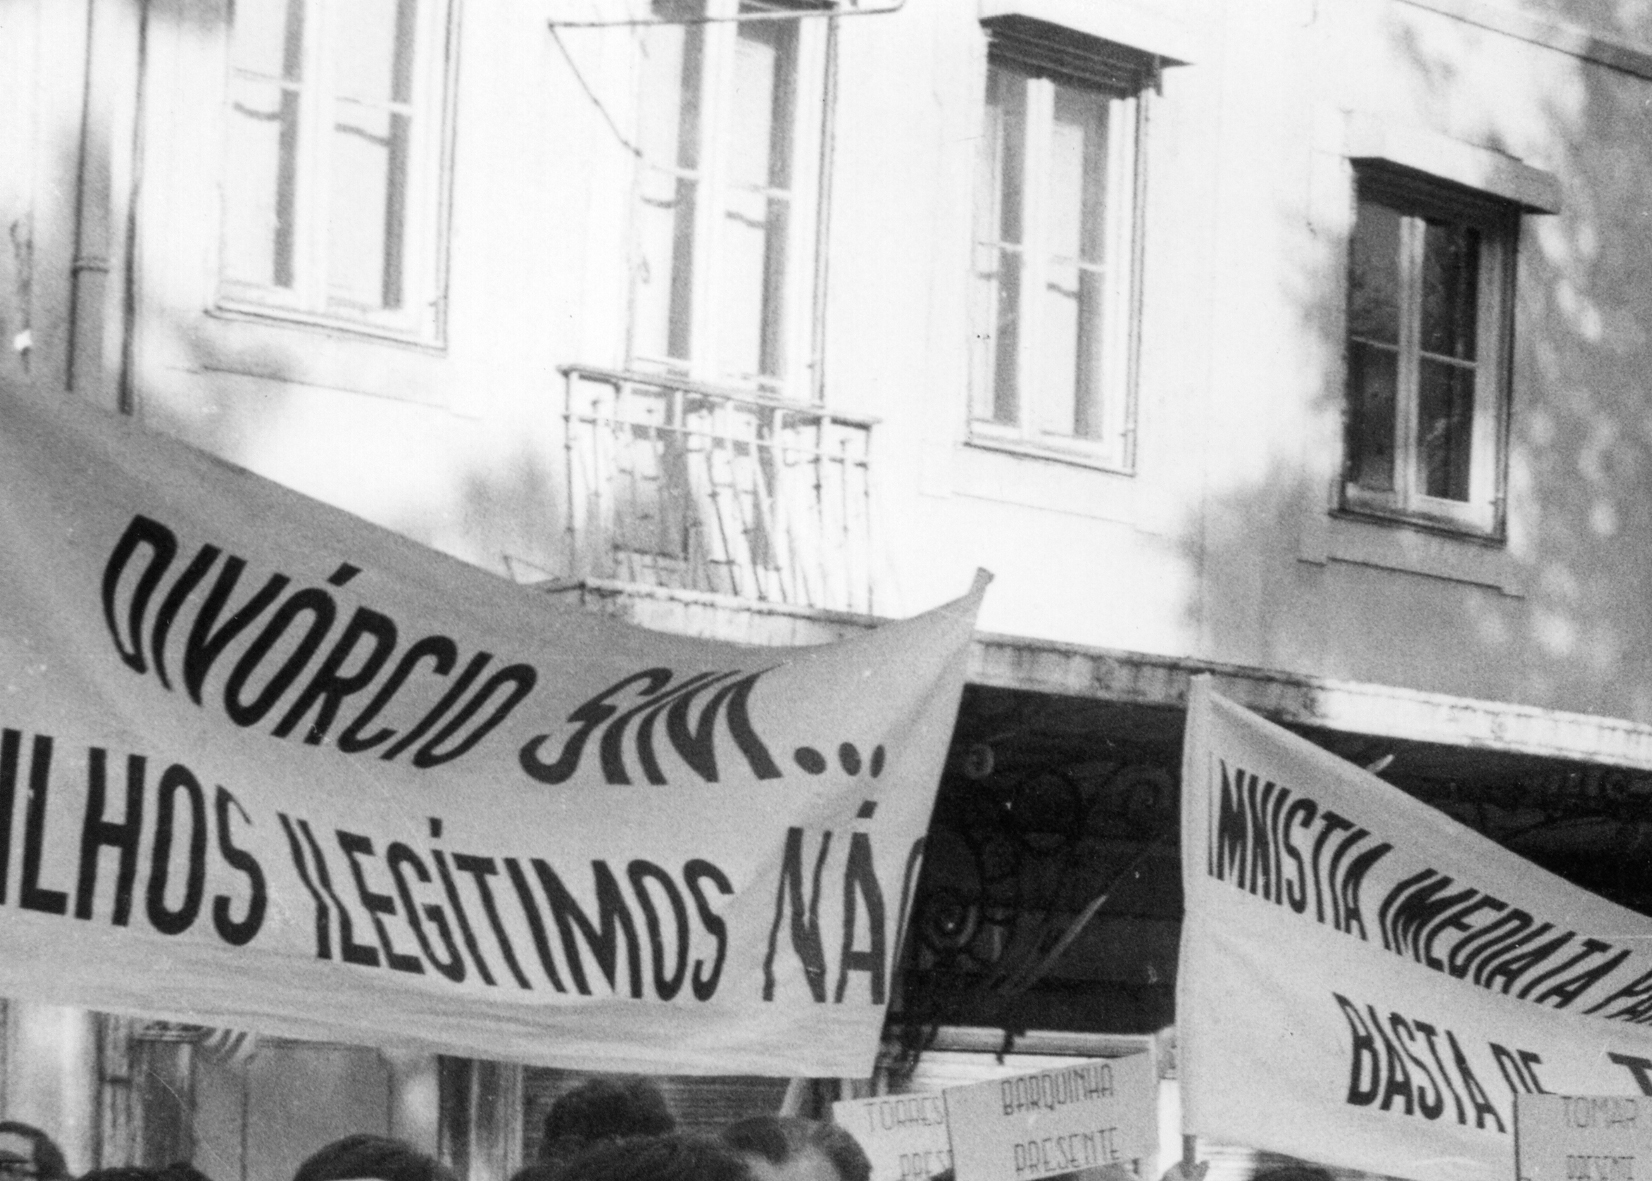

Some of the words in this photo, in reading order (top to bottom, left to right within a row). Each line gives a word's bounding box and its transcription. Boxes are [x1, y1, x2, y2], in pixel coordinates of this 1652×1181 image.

[102, 513, 537, 768] DIVÓRCIO
[0, 727, 267, 946] ILHOS
[1378, 868, 1633, 1010] IMEDIATA
[1001, 1062, 1115, 1116] BARQUINHA
[1332, 992, 1506, 1134] BASTA
[1013, 1126, 1120, 1176] PRESENTE
